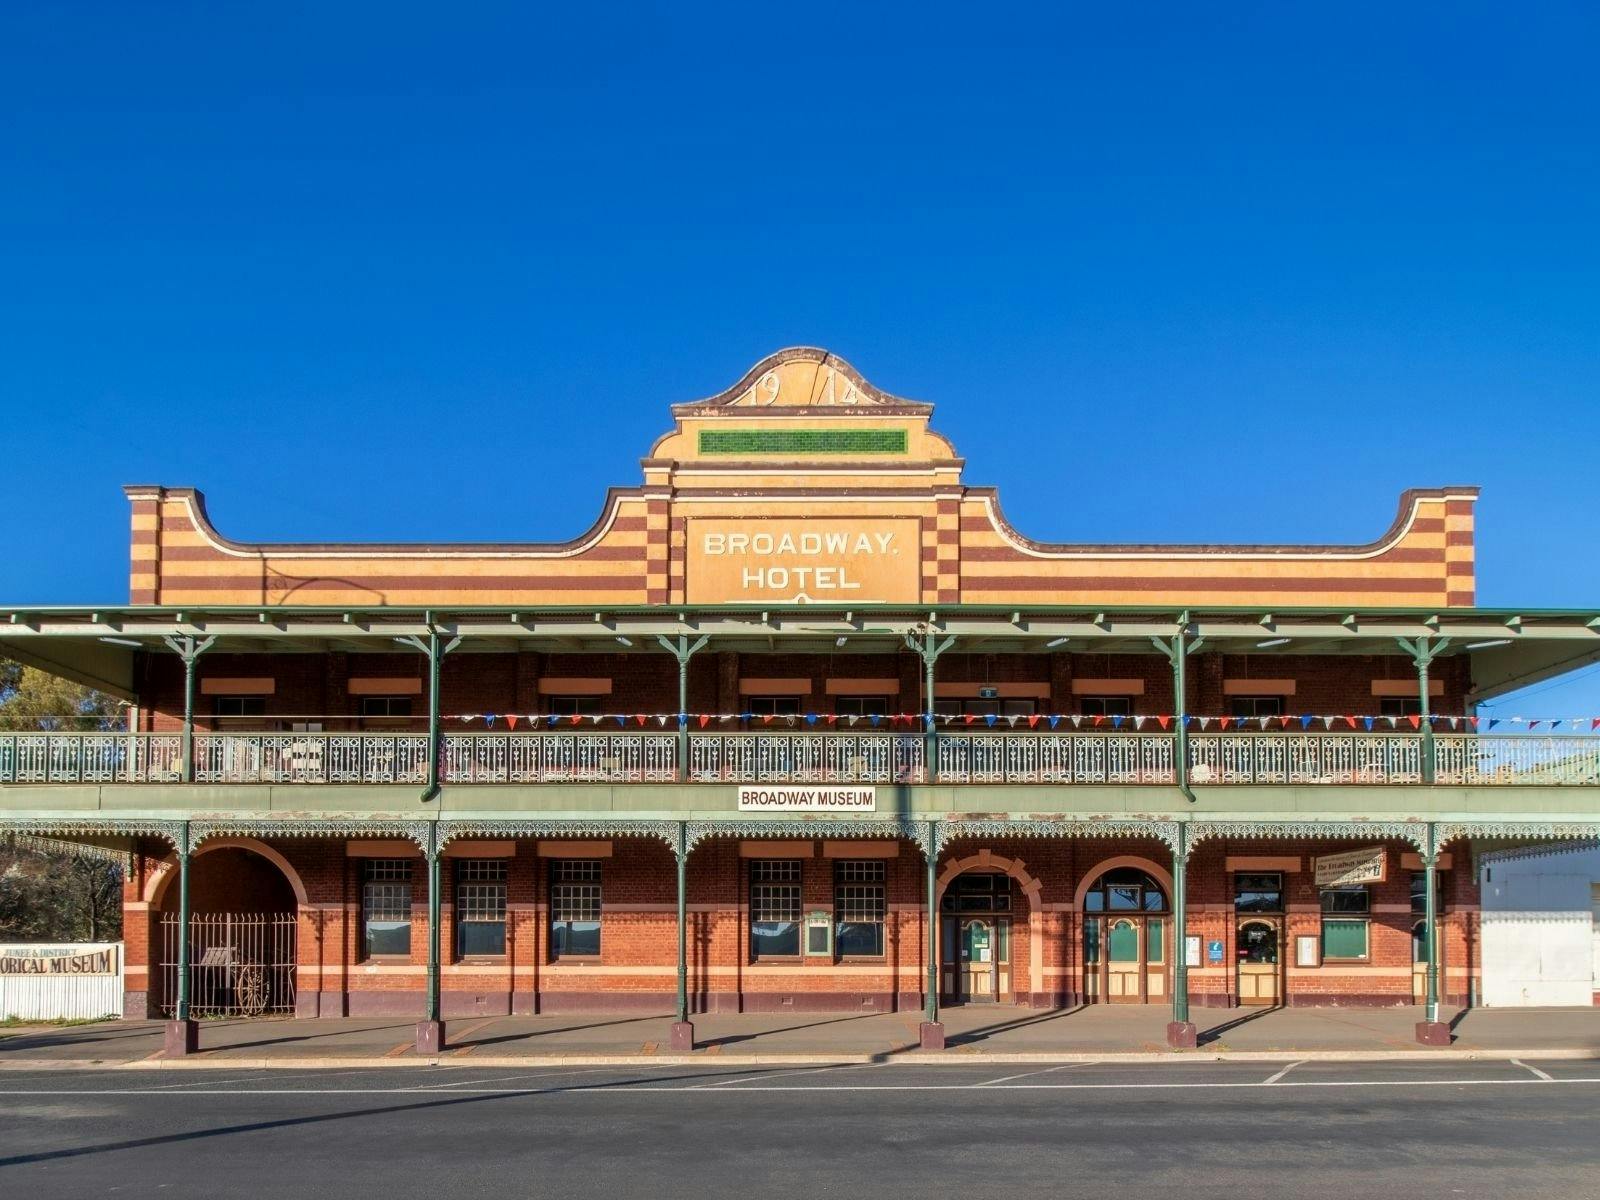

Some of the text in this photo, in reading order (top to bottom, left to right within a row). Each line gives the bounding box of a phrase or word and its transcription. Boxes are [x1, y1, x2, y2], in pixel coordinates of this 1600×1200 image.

[704, 532, 899, 555] BROADWAY.
[742, 567, 861, 589] HOTEL
[742, 791, 873, 805] BROADWAY MUSEUM
[0, 949, 112, 974] ORICAL MUSEUM
[32, 949, 38, 958] &
[40, 948, 77, 957] DISTRICT
